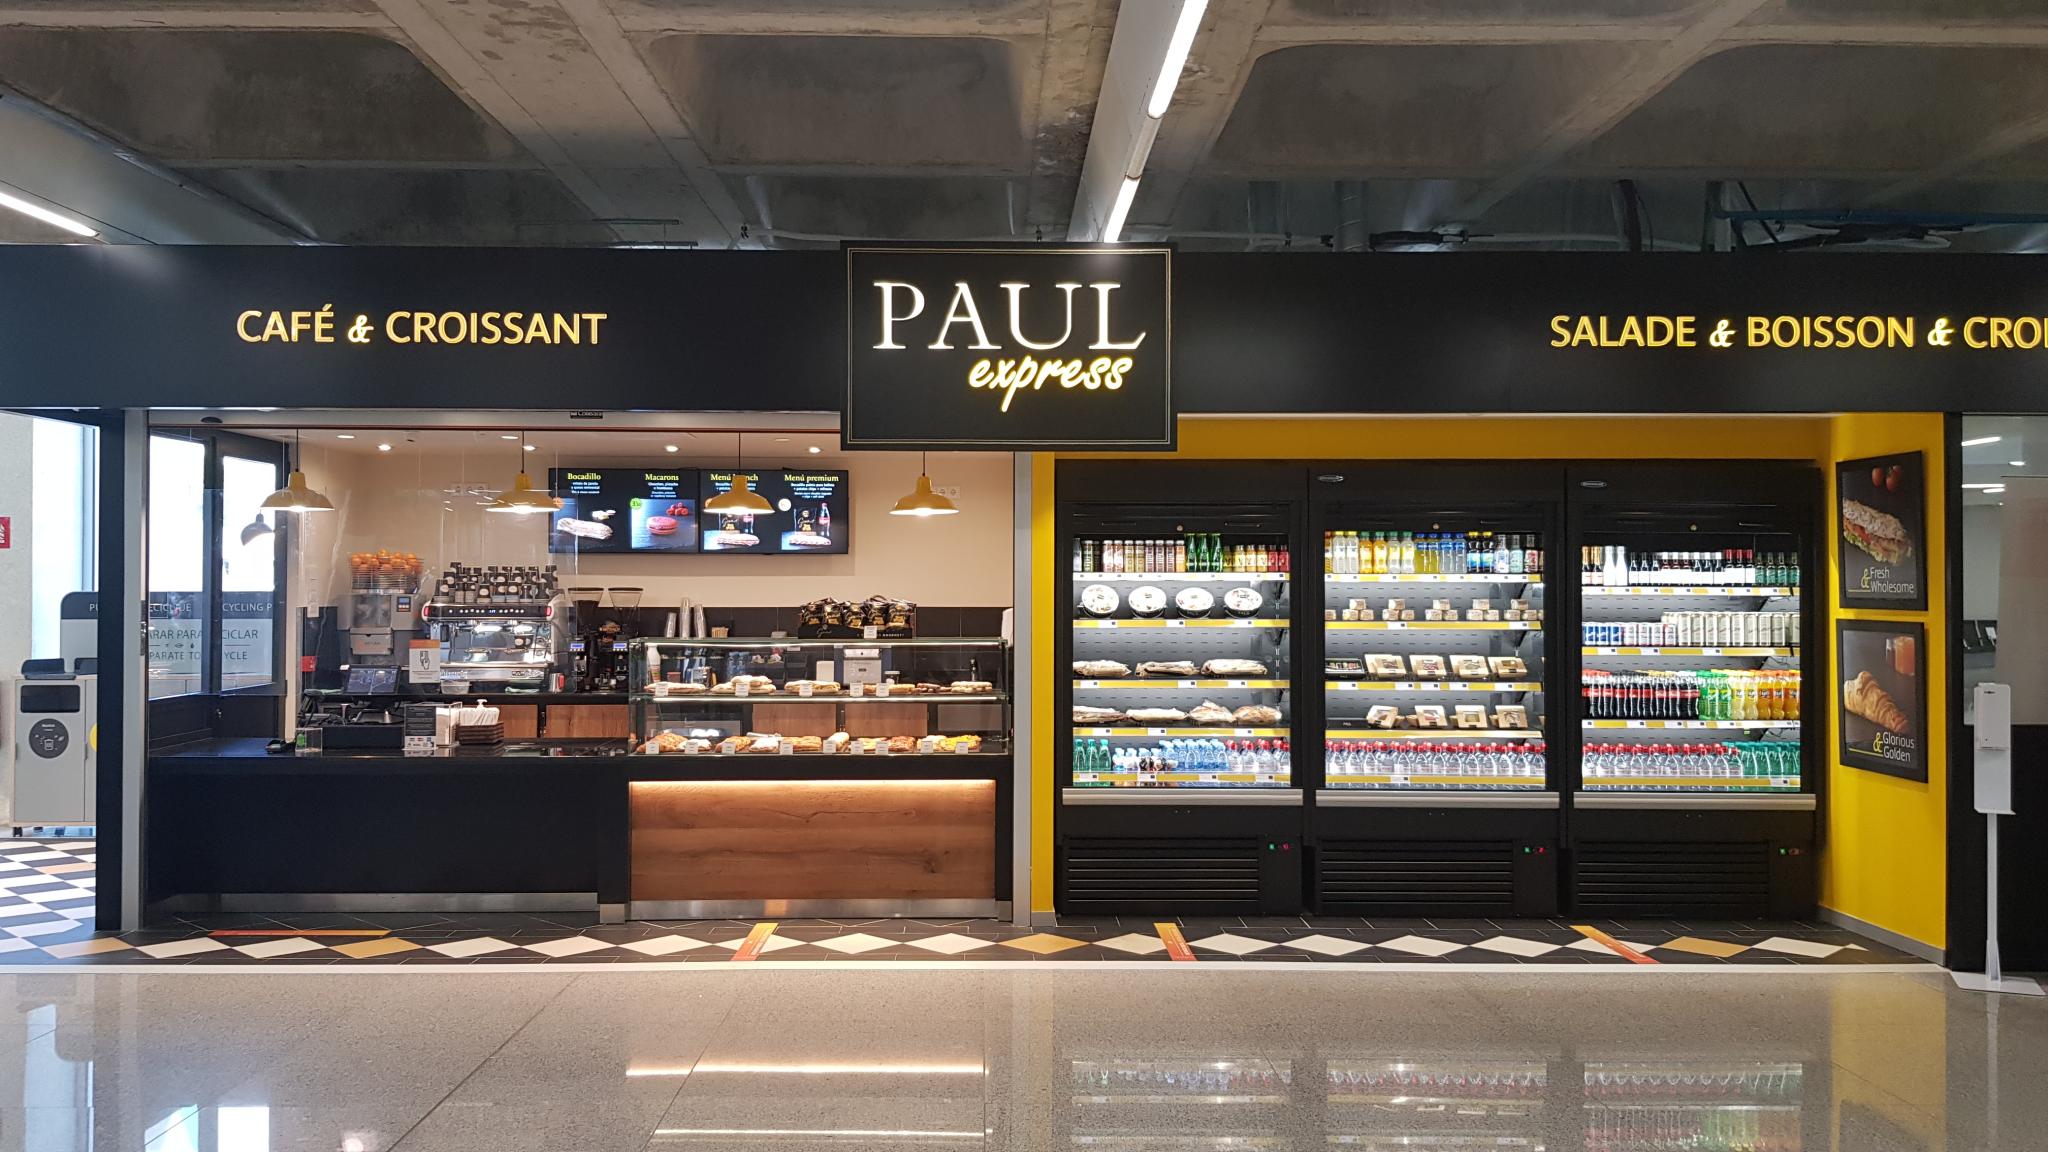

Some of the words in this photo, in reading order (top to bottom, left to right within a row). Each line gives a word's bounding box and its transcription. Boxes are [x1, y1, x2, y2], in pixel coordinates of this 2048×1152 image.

[872, 281, 1147, 351] PAUL
[236, 303, 335, 343] CAFÉ
[347, 314, 375, 344] &
[385, 311, 608, 345] CROISSANT
[1550, 315, 1697, 348] SALADE
[1709, 319, 1737, 348] &
[1747, 315, 1915, 349] BOISSON
[1927, 317, 1956, 347] &
[968, 355, 1134, 413] express
[567, 472, 602, 480] Bocadillo
[645, 473, 680, 481] Macarons
[710, 473, 732, 481] Menú
[784, 473, 805, 481] Menú
[806, 474, 839, 483] premium
[1870, 566, 1890, 579] Fresh
[1870, 580, 1915, 594] Wholesome
[1882, 731, 1915, 749] Glorious
[1883, 746, 1911, 762] Golden
